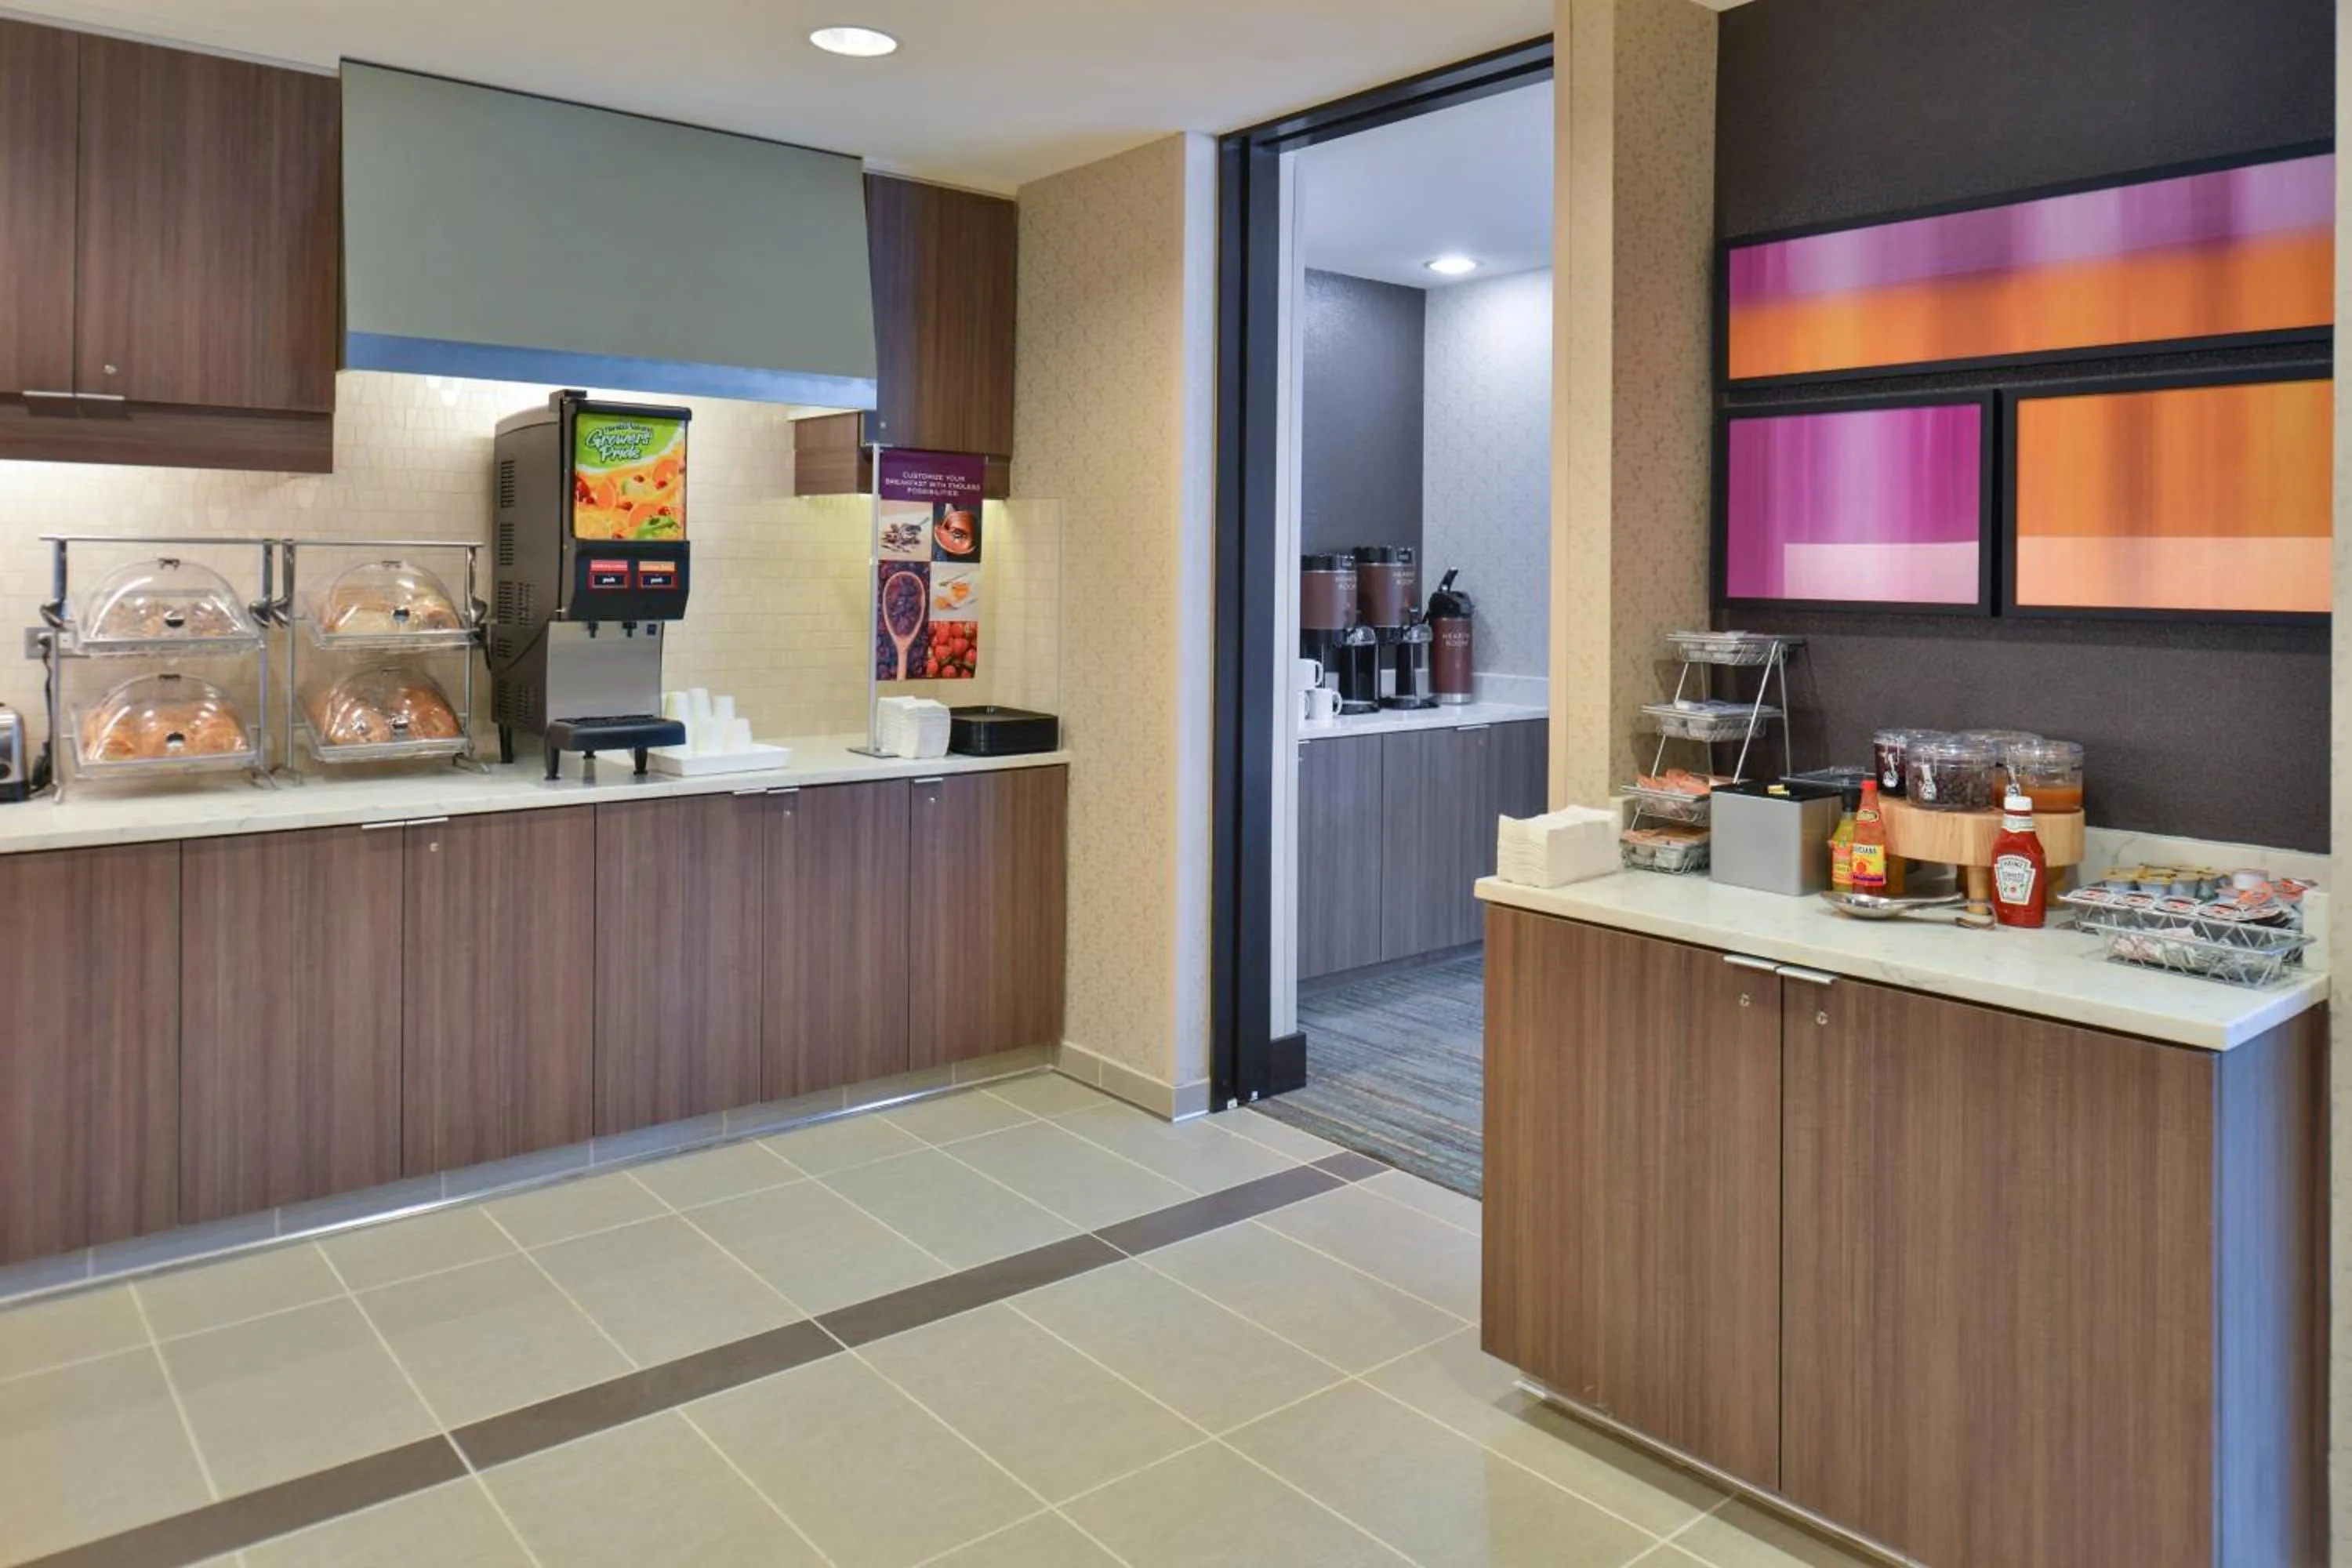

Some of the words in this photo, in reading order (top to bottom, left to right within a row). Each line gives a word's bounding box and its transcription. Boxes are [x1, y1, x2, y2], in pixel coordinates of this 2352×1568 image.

[599, 445, 641, 463] Pride
[902, 471, 943, 481] CUSTOMIZE
[885, 477, 927, 487] BREAKFAST
